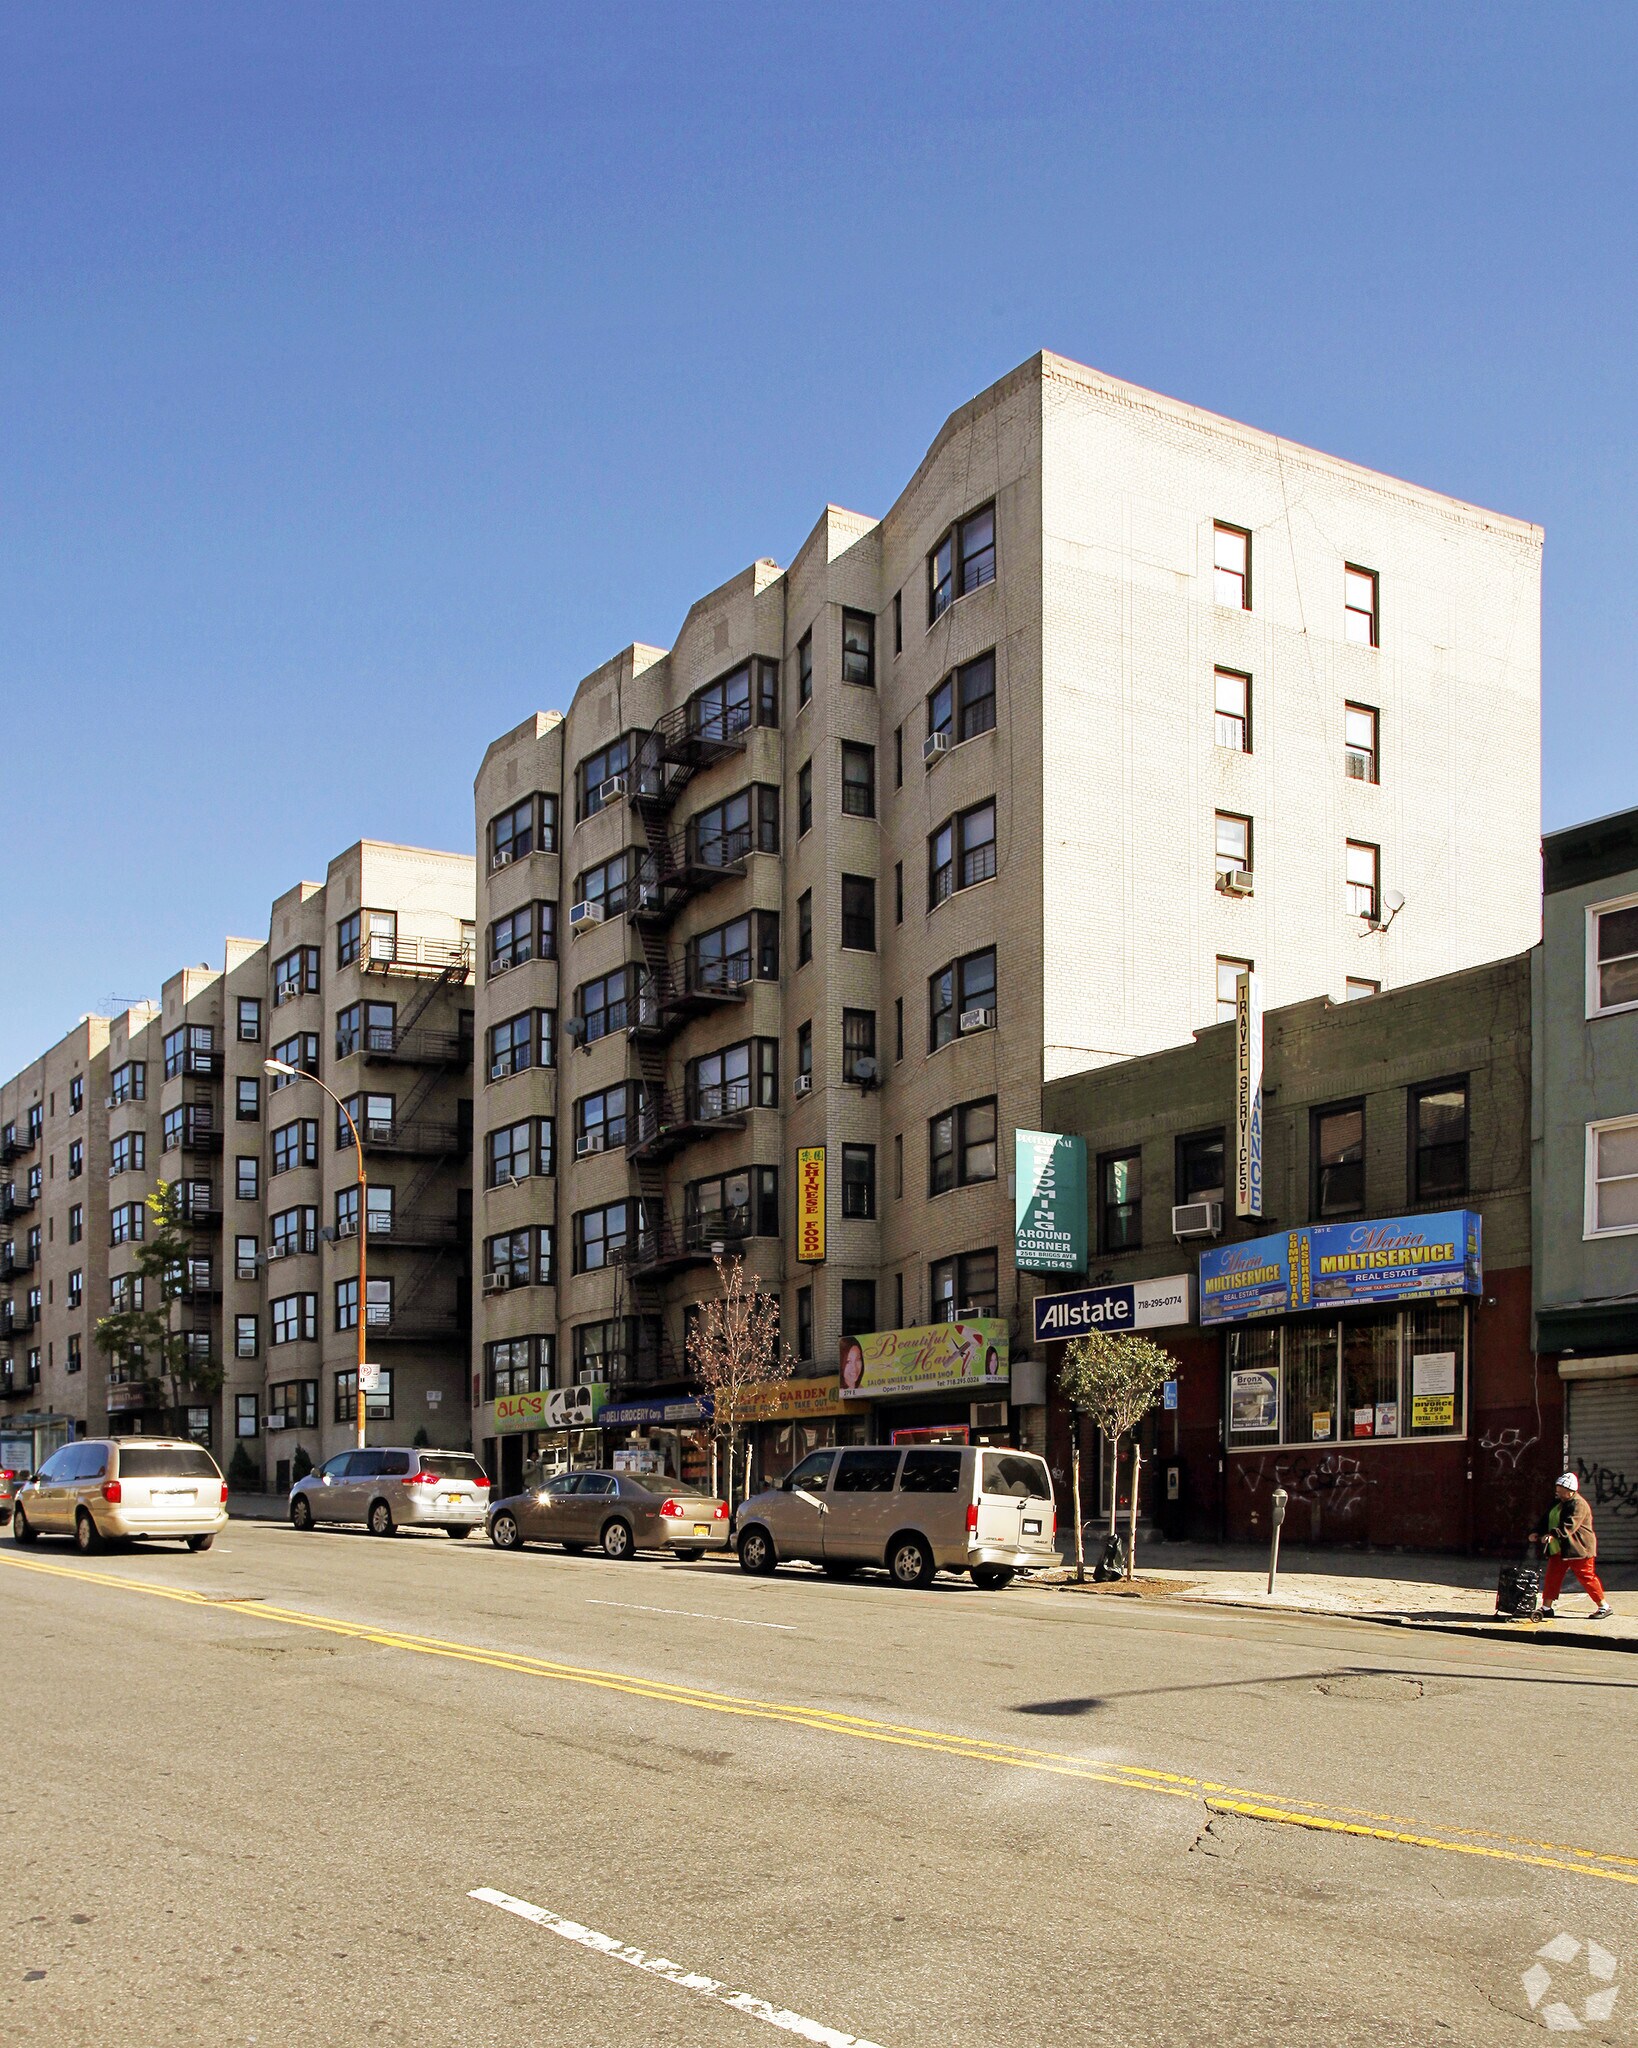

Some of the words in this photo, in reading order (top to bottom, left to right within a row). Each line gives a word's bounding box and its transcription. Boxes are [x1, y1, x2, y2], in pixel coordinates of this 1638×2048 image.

[1239, 985, 1247, 1071] TRAVEL
[1239, 1076, 1248, 1191] SERVICES
[804, 1161, 819, 1214] CHINESE
[1033, 1144, 1056, 1231] GROOMING
[804, 1221, 819, 1252] FOOD
[1017, 1229, 1071, 1241] AROUND
[1018, 1239, 1071, 1252] CORNER
[1347, 1224, 1426, 1253] Maria
[1018, 1258, 1073, 1269] 562-1545
[1288, 1232, 1299, 1309] COMMERCIAL
[1300, 1235, 1310, 1304] INSURANCE
[1320, 1243, 1455, 1274] MULTISERVICE
[1205, 1264, 1280, 1294] MULTISERVICE
[1355, 1272, 1380, 1282] REAL
[1383, 1268, 1419, 1280] ESTATE
[1224, 1292, 1238, 1301] REAL
[1239, 1289, 1259, 1299] ESTATE
[1040, 1297, 1129, 1330] Allstate
[1138, 1295, 1182, 1310] 718-295-0774
[863, 1328, 949, 1360] Beautiful
[780, 1388, 826, 1400] GARDEN
[867, 1378, 886, 1387] SALON
[887, 1375, 907, 1385] UNISEX
[914, 1372, 937, 1381] BARBER
[882, 1386, 897, 1394] Open
[606, 1410, 619, 1423] DELI
[620, 1408, 649, 1422] GROCERY
[781, 1402, 789, 1410] TO
[794, 1401, 811, 1409] TAKE
[814, 1399, 828, 1407] OUT
